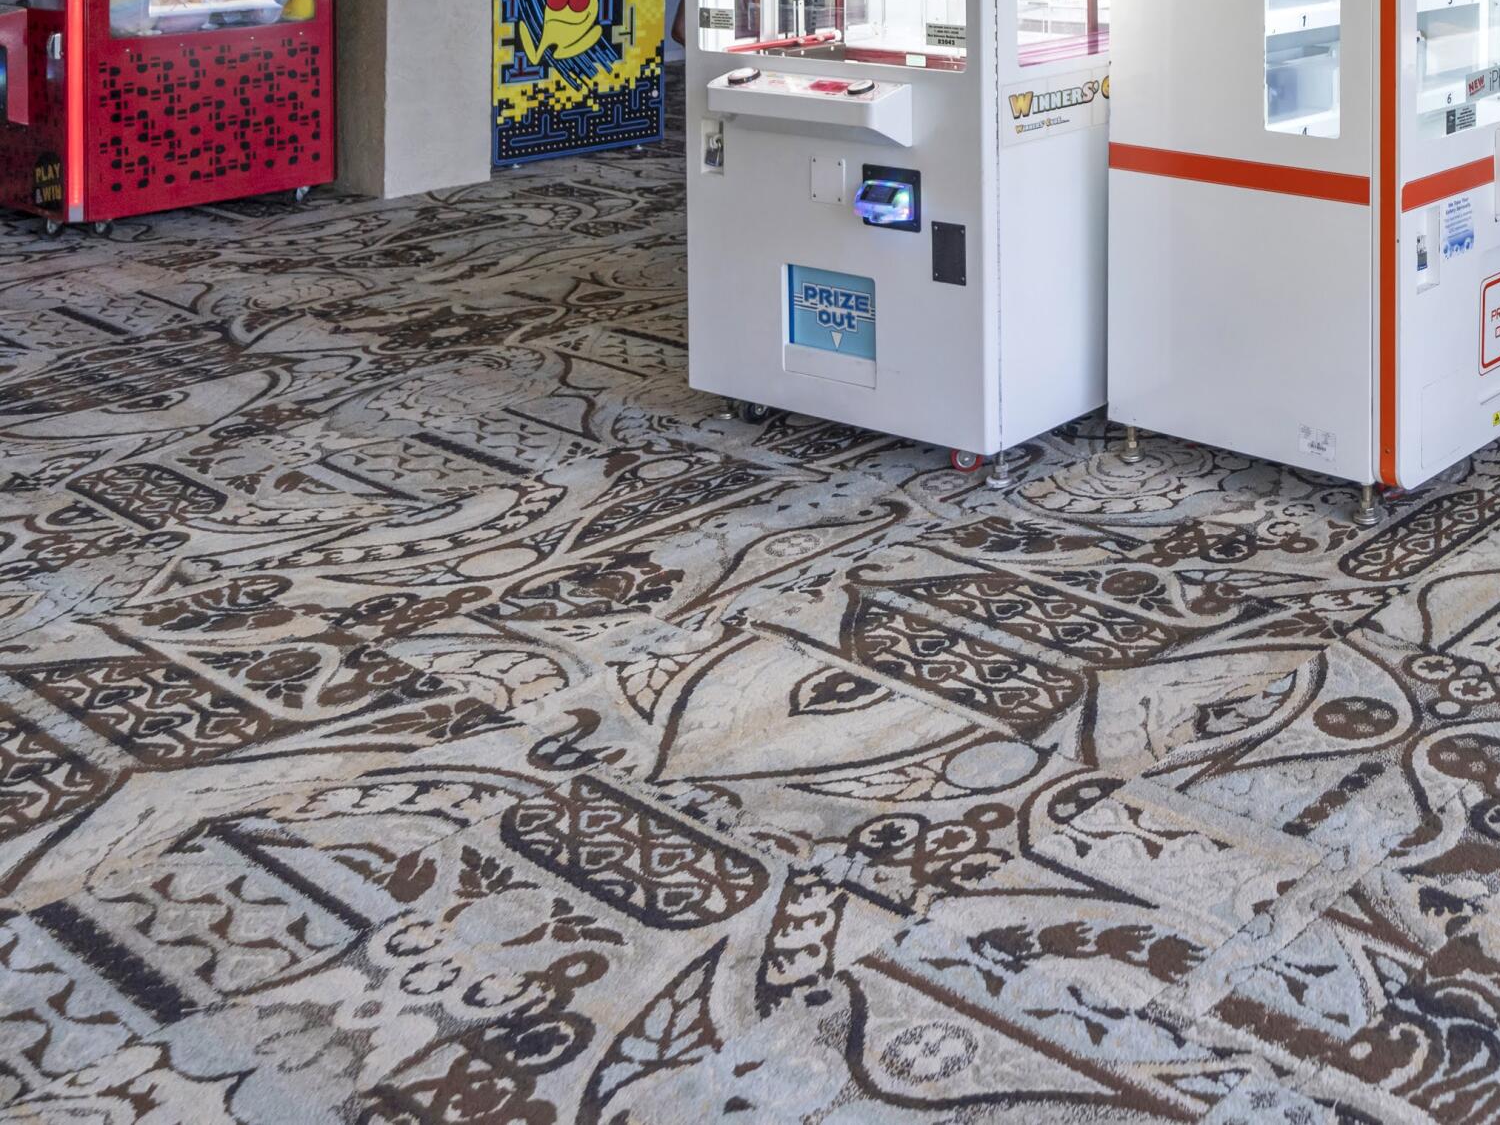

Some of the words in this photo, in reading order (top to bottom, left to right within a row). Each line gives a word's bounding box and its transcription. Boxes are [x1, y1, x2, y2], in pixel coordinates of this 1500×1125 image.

[1468, 74, 1485, 93] NEW
[1008, 80, 1100, 120] WINNERS'
[35, 163, 60, 183] PLAY
[43, 185, 62, 202] WIN
[803, 284, 870, 313] PRIZE
